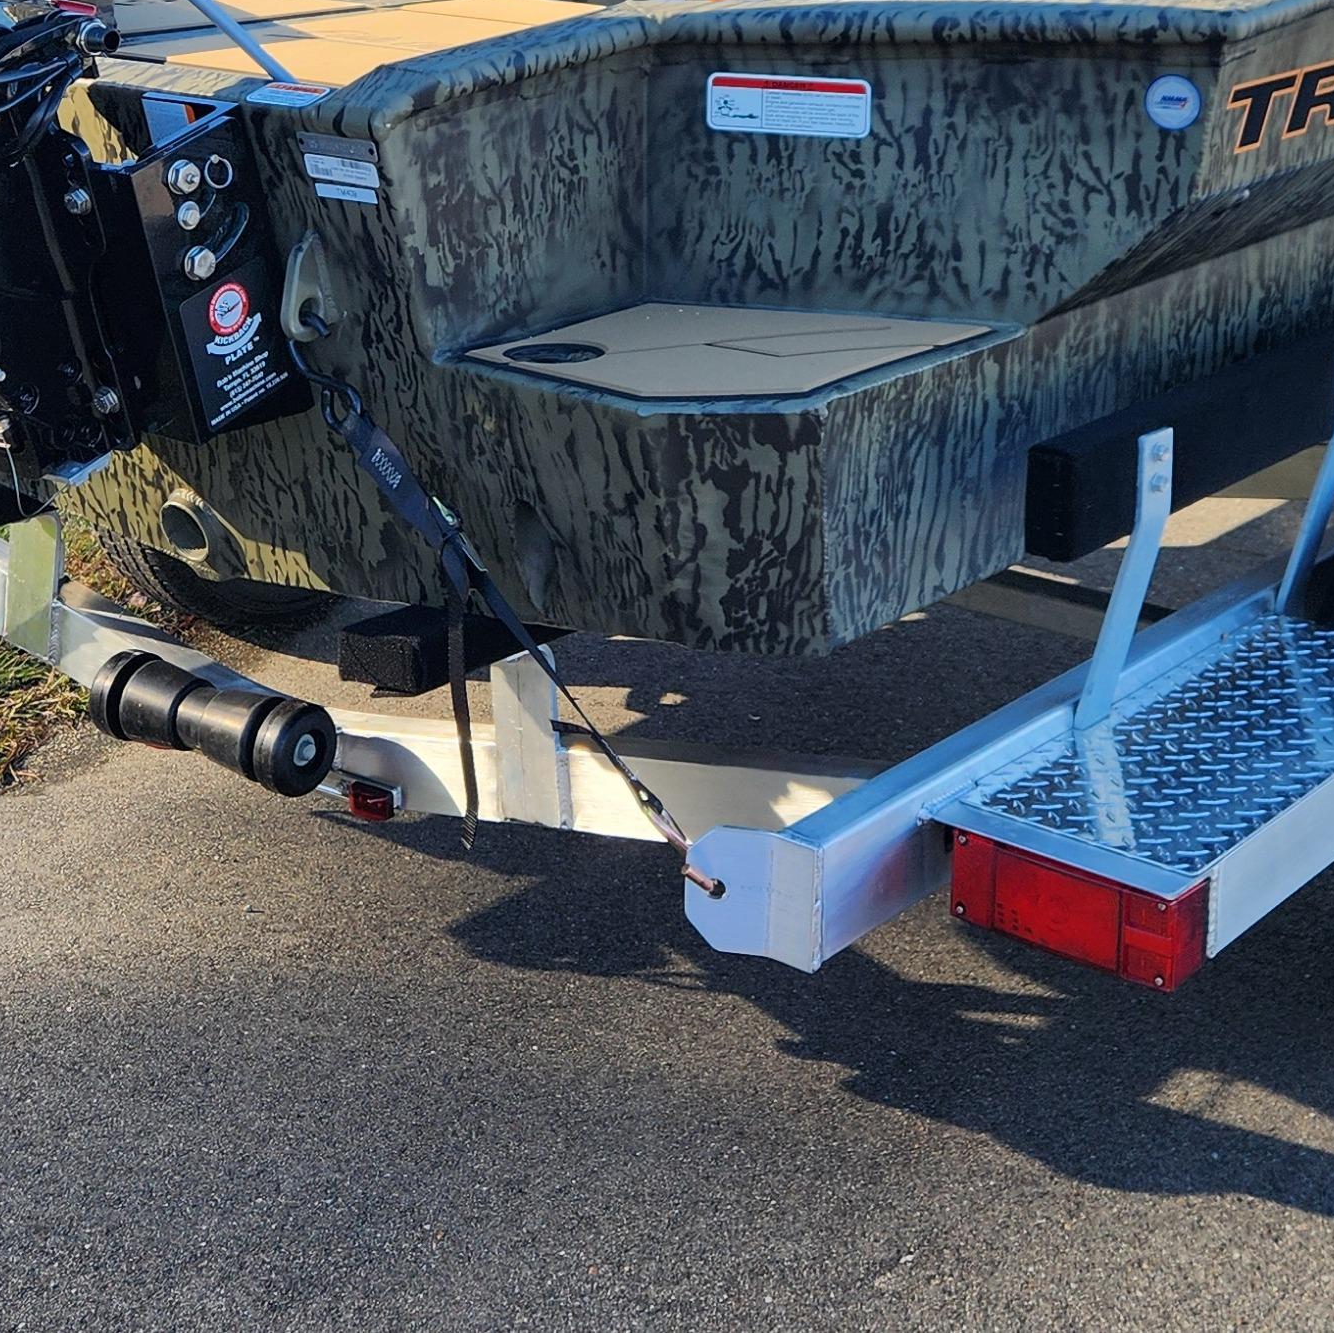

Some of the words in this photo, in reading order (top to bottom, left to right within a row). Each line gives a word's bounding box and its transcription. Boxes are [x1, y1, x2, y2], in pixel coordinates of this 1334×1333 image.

[214, 316, 254, 345] KICKBACK
[224, 341, 255, 366] PLATE
[232, 360, 255, 377] Machine
[254, 350, 269, 364] Shop
[210, 413, 225, 426] MADE
[231, 403, 242, 413] USA
